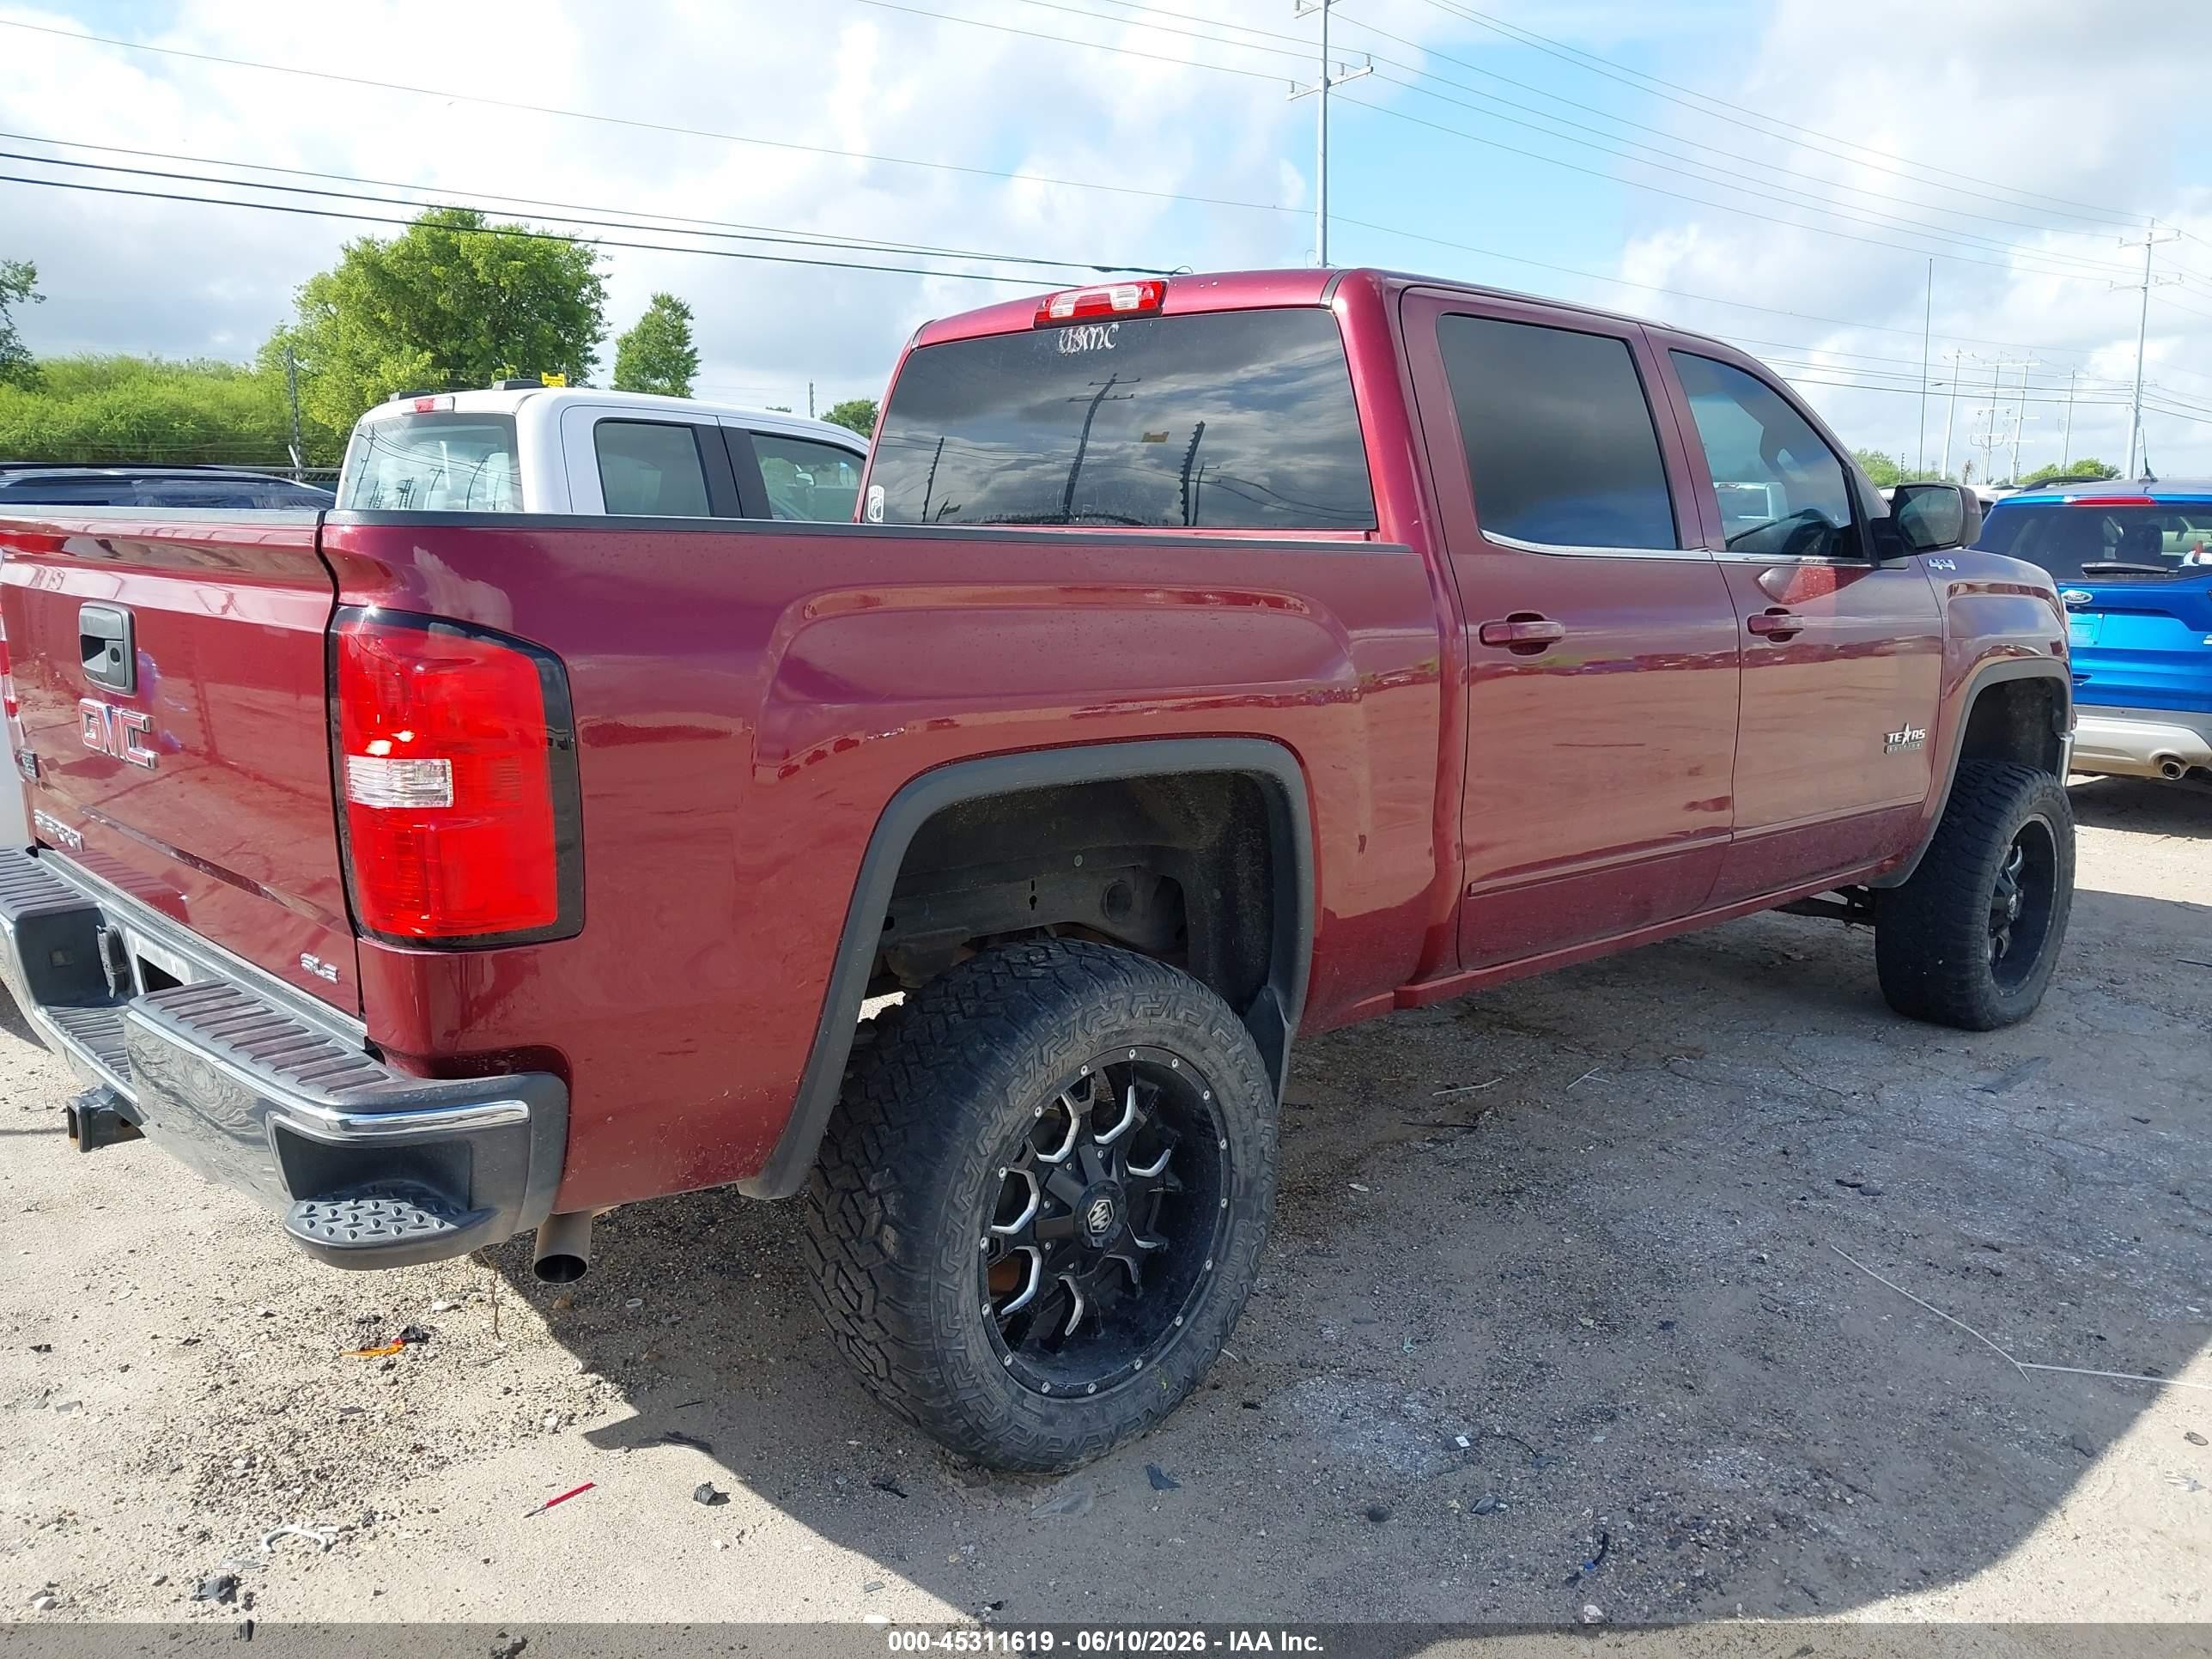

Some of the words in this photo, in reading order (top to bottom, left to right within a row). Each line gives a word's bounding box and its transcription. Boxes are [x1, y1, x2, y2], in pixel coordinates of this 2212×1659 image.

[79, 698, 159, 769] GMC
[1887, 722, 1926, 745] TEXAS
[300, 952, 338, 985] SLE
